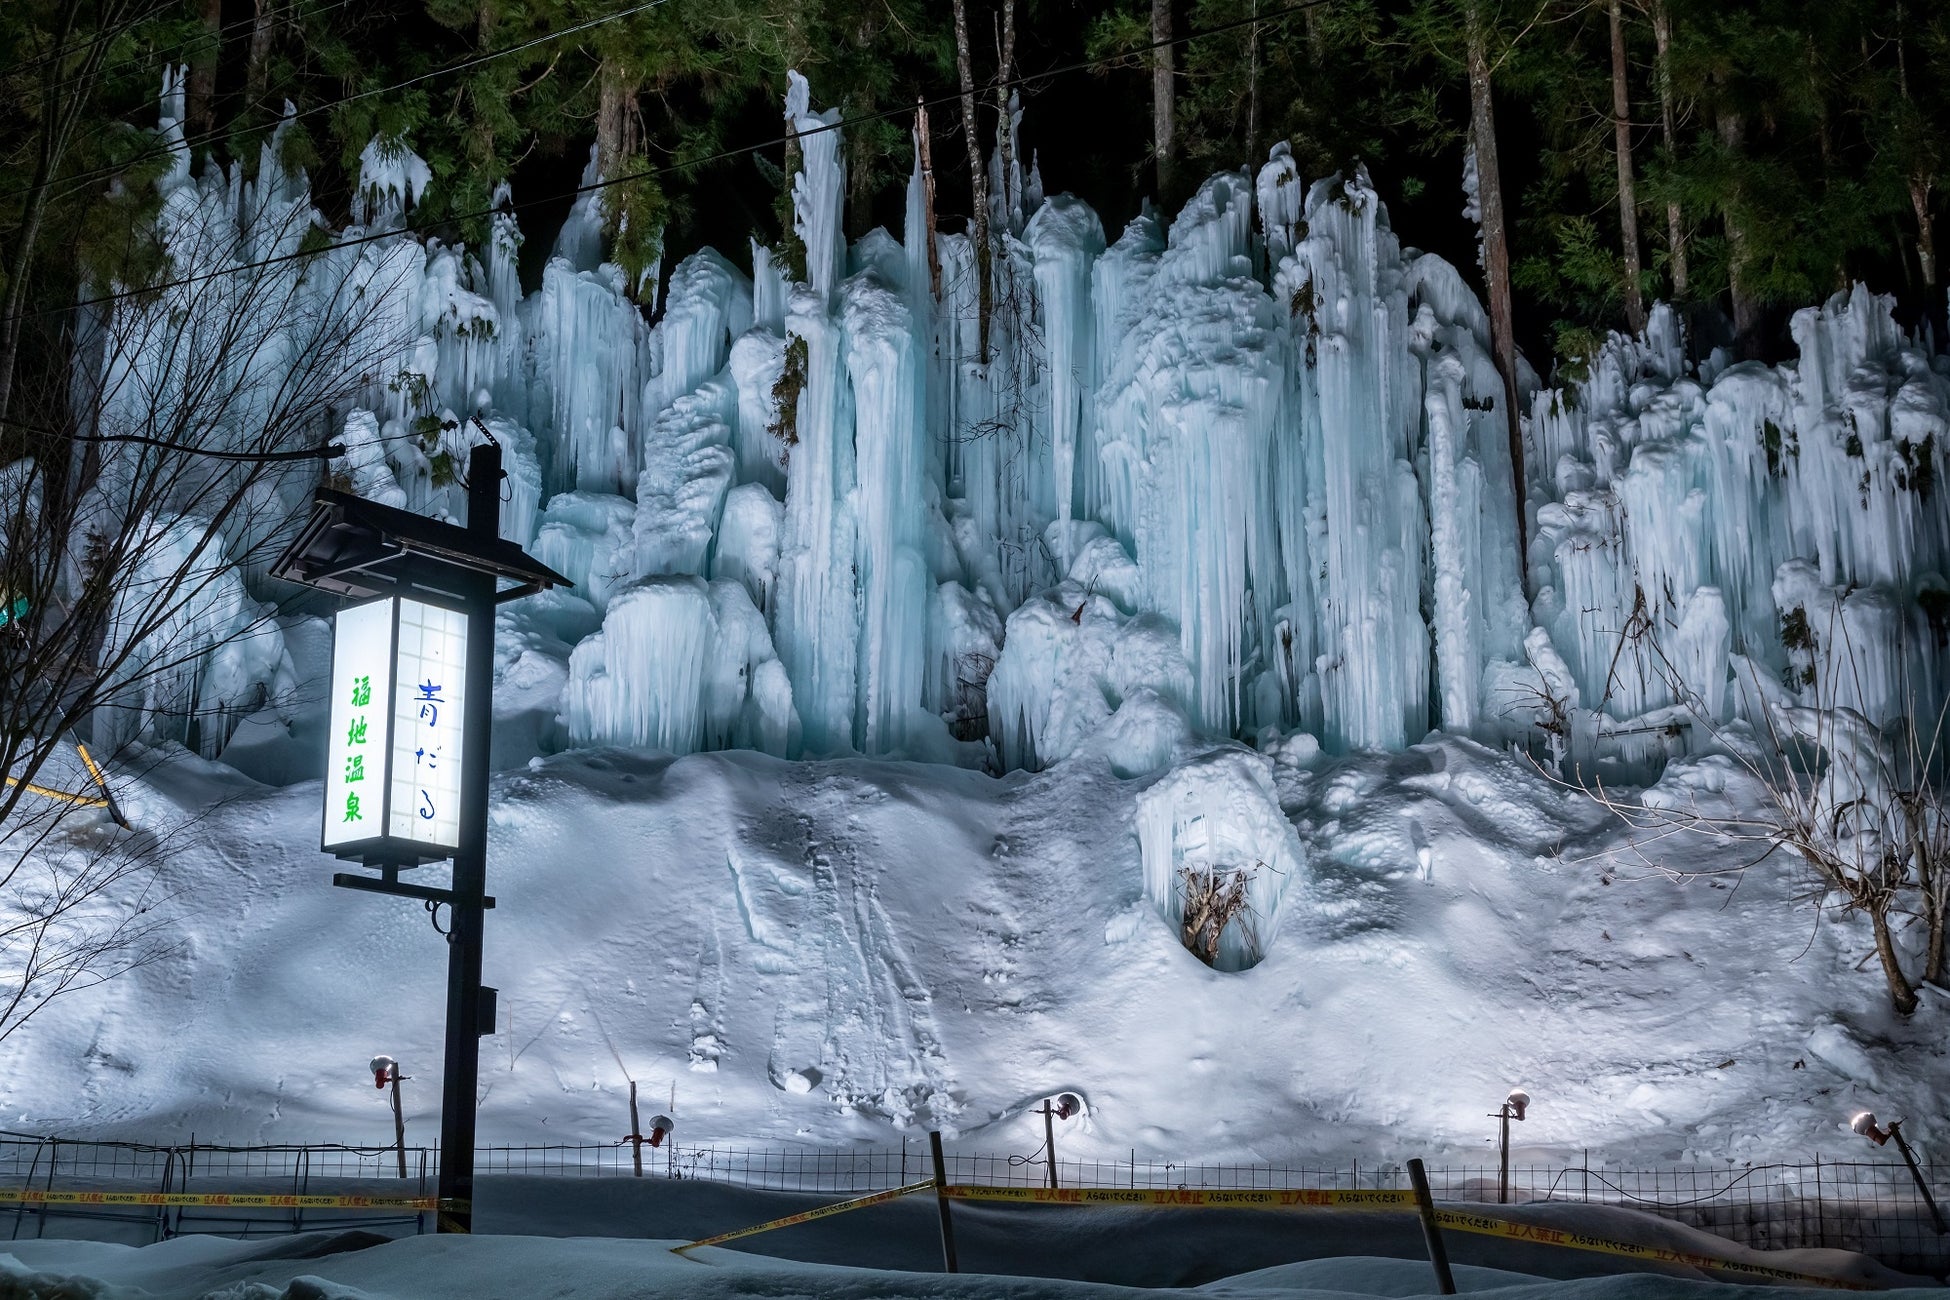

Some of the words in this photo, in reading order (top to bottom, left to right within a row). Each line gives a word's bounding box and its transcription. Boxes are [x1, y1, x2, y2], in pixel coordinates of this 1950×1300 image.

[342, 675, 371, 823] 福地温泉
[414, 678, 445, 820] 青だる
[1034, 1190, 1082, 1202] 立入禁止
[1086, 1191, 1147, 1202] 入らないでください
[1153, 1191, 1205, 1204] 立入禁止
[1208, 1193, 1272, 1203] 入らないでください
[1279, 1192, 1334, 1206] 立入禁止
[1338, 1193, 1405, 1204] 入らないでください
[1506, 1222, 1565, 1245] 立入禁止
[1570, 1233, 1645, 1254] 入らないでください
[1654, 1249, 1716, 1268] 立入禁止
